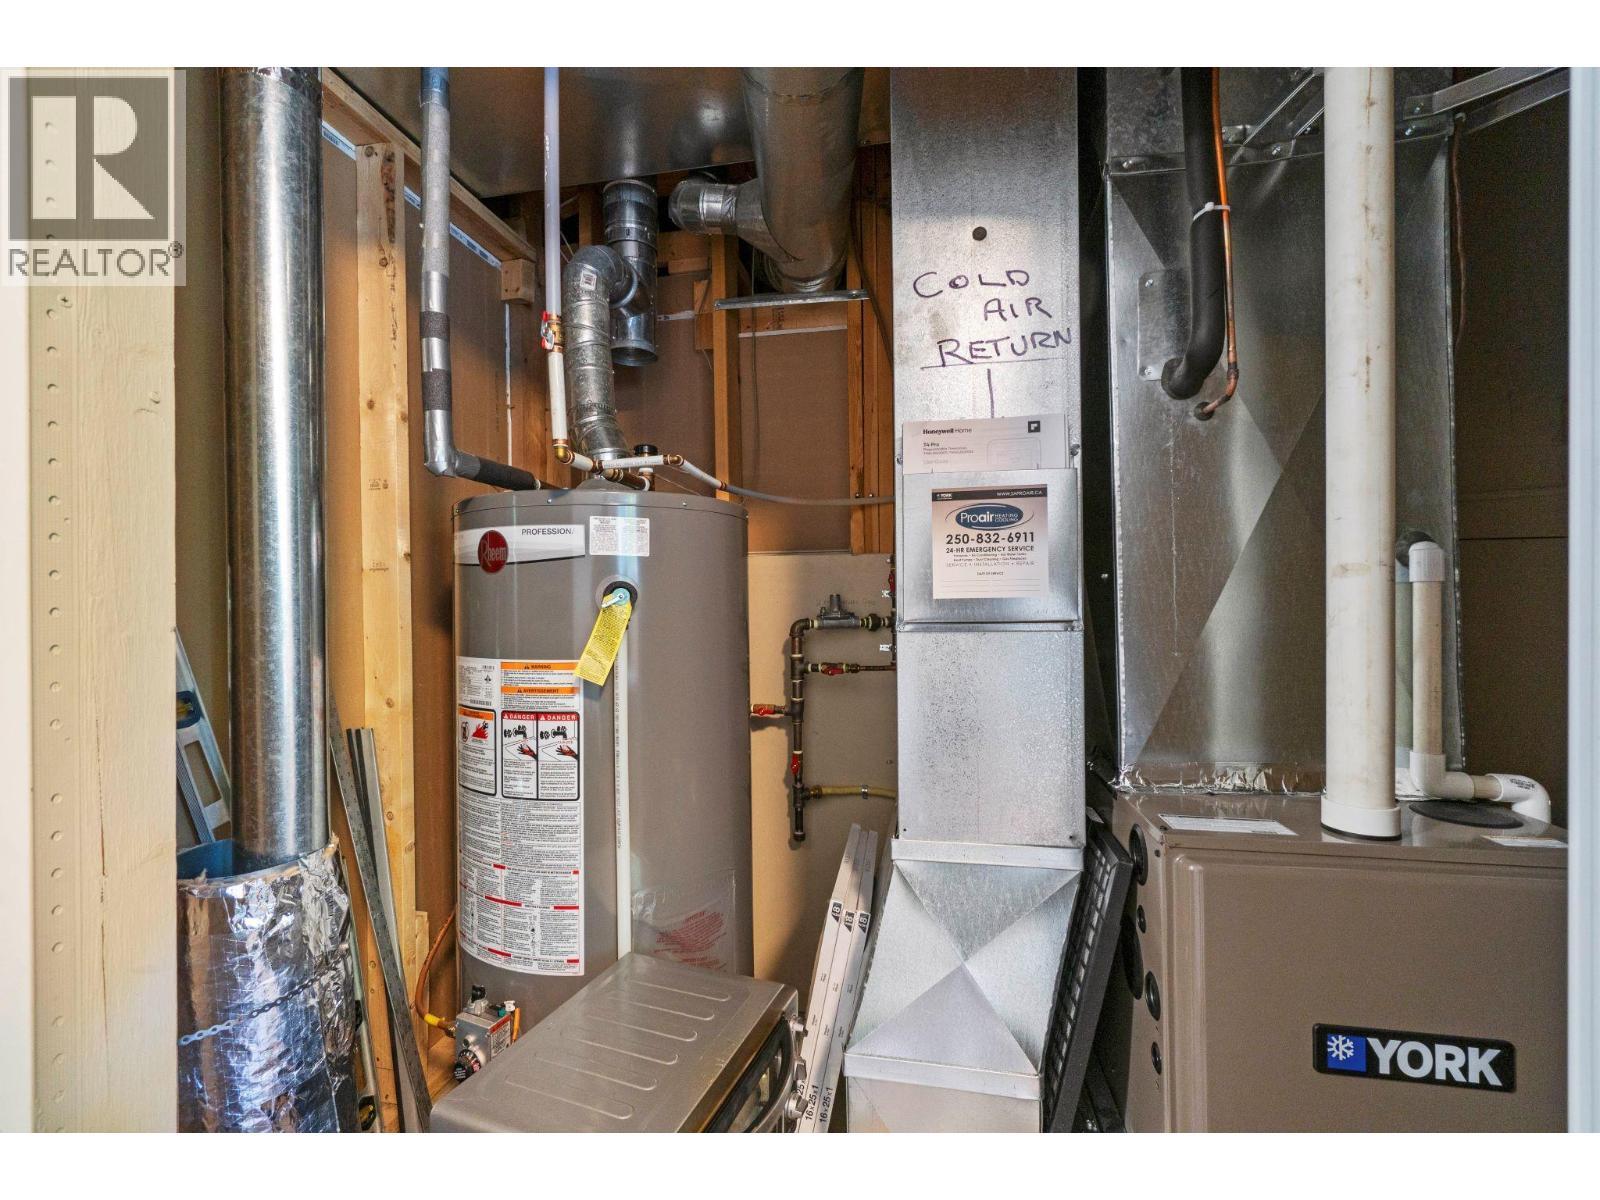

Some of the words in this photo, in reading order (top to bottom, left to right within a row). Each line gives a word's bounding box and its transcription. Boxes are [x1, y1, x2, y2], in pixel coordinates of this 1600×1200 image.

[913, 269, 1030, 298] COLD
[984, 297, 1052, 321] AIR
[937, 327, 1072, 367] RETURN
[922, 428, 954, 436] Honeywell
[521, 527, 575, 536] PROFESSION
[960, 511, 994, 523] Proair
[481, 538, 506, 567] Rheem
[945, 532, 1035, 545] 250-832-6911
[1366, 1037, 1503, 1087] YORK
[805, 1084, 819, 1120] 16x25x1
[819, 1087, 833, 1122] 16x25x1
